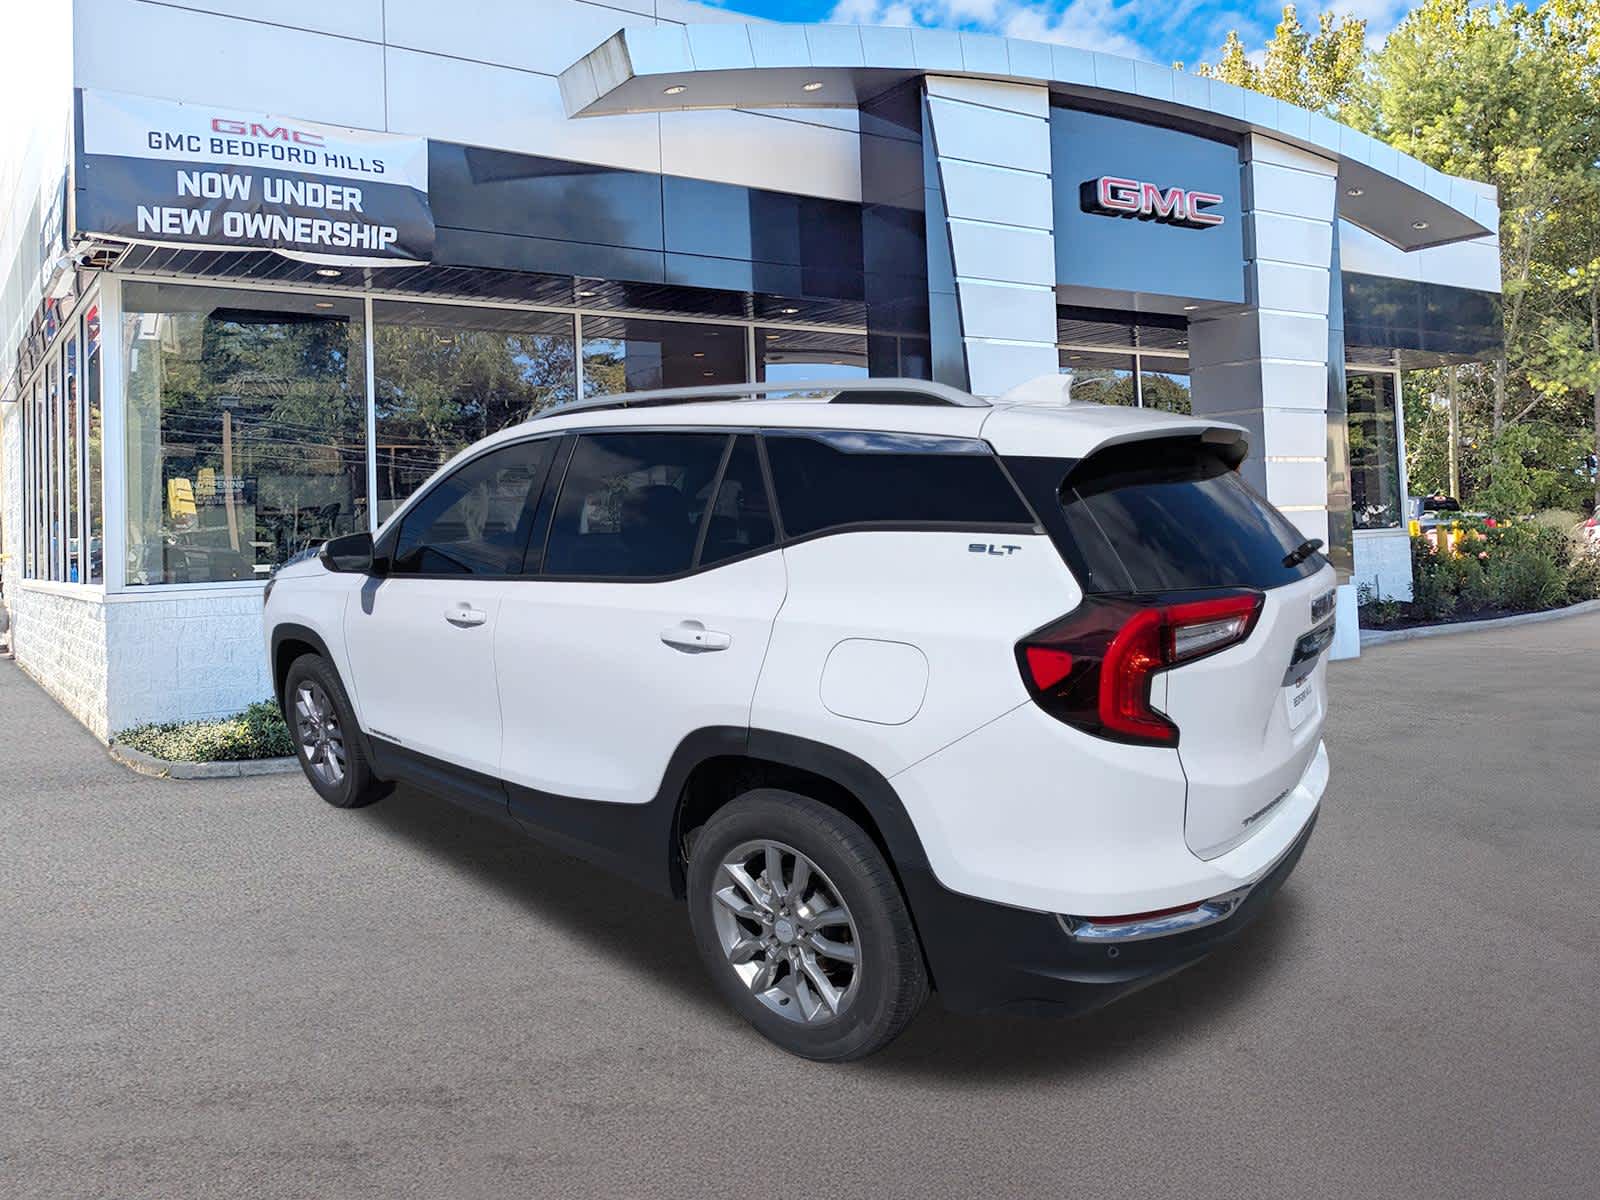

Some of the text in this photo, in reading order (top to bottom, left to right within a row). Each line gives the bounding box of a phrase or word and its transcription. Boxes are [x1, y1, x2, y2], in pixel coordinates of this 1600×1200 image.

[147, 131, 385, 174] GMC BEDFORD HILLS
[211, 117, 326, 147] GMC
[176, 170, 363, 212] NOW UNDER
[1096, 175, 1224, 225] GMC
[136, 205, 398, 250] NEW OWNERSHIP
[968, 543, 1022, 556] SLT
